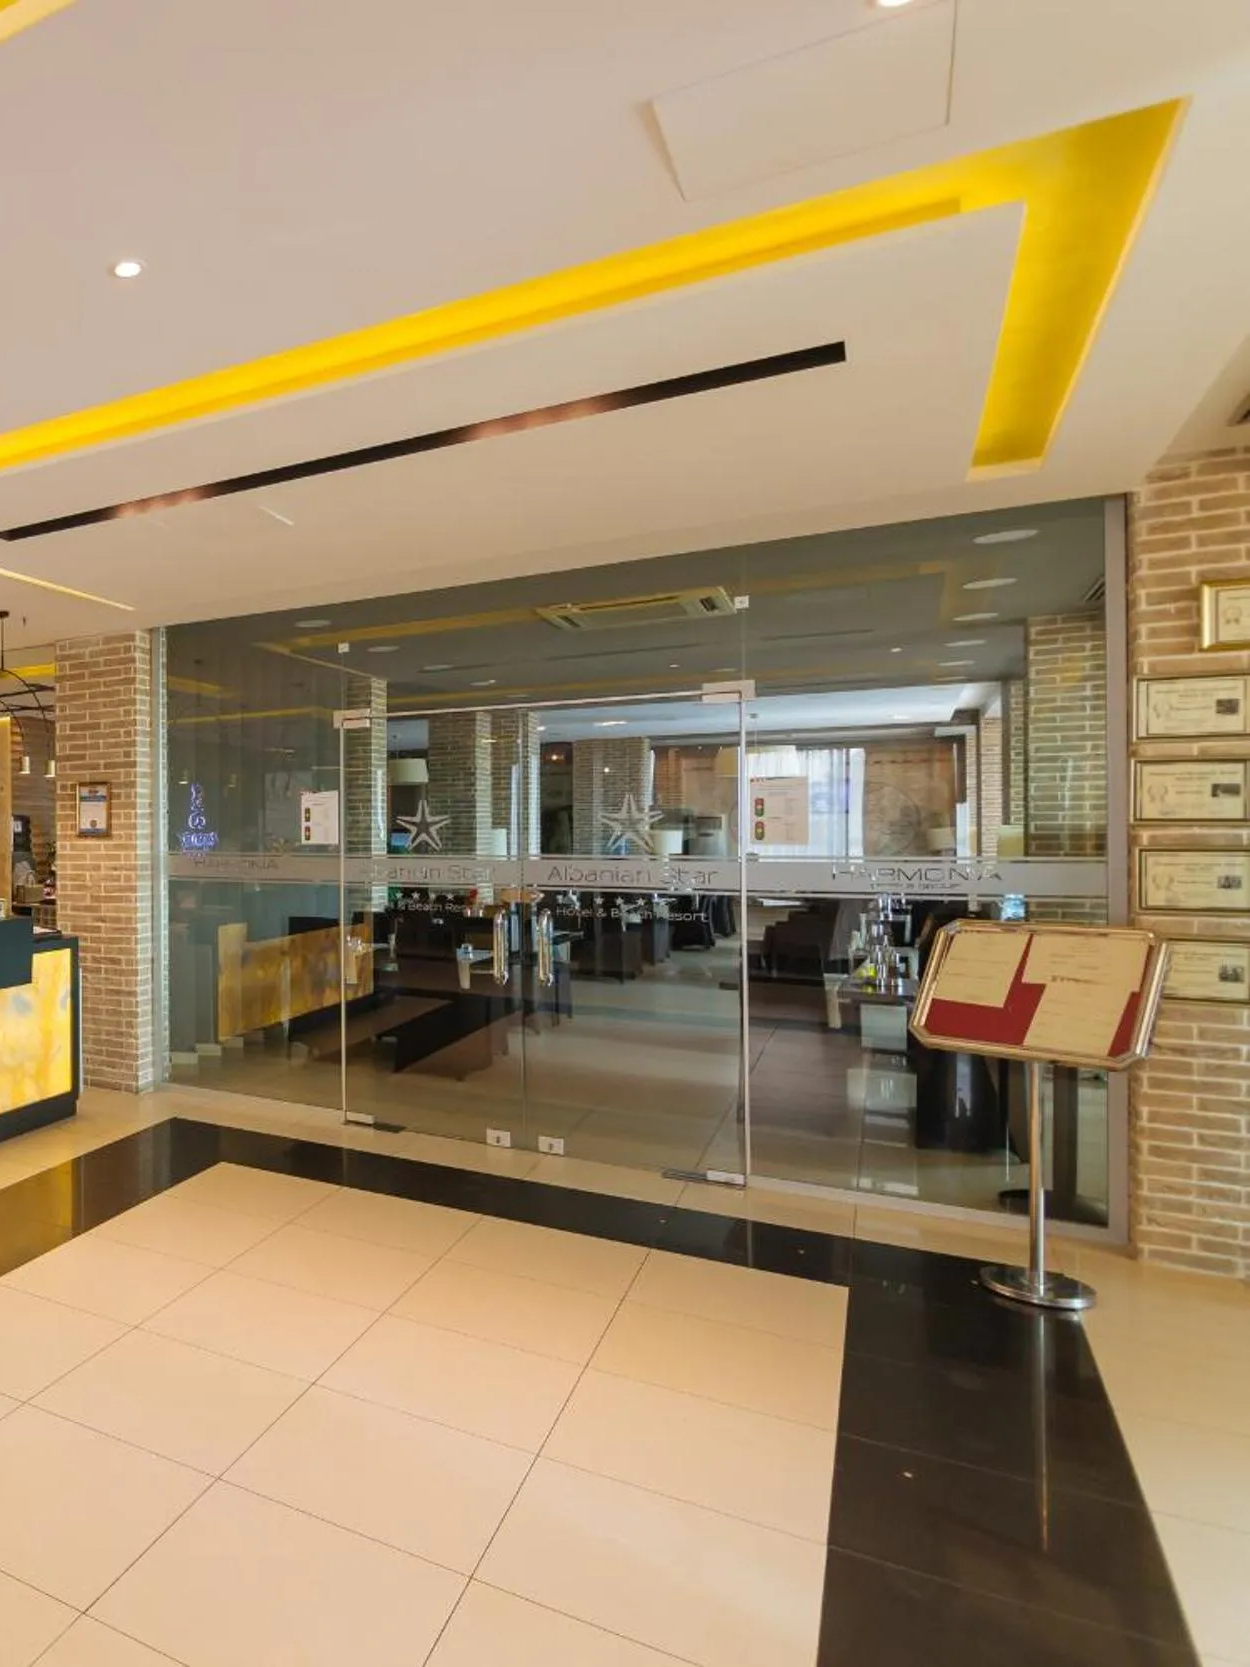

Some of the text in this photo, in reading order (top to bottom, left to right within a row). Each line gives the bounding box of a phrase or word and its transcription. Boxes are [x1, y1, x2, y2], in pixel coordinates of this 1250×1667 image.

[547, 864, 719, 885] Albanian Star
[831, 866, 1003, 882] HARMONA
[595, 908, 608, 918] &
